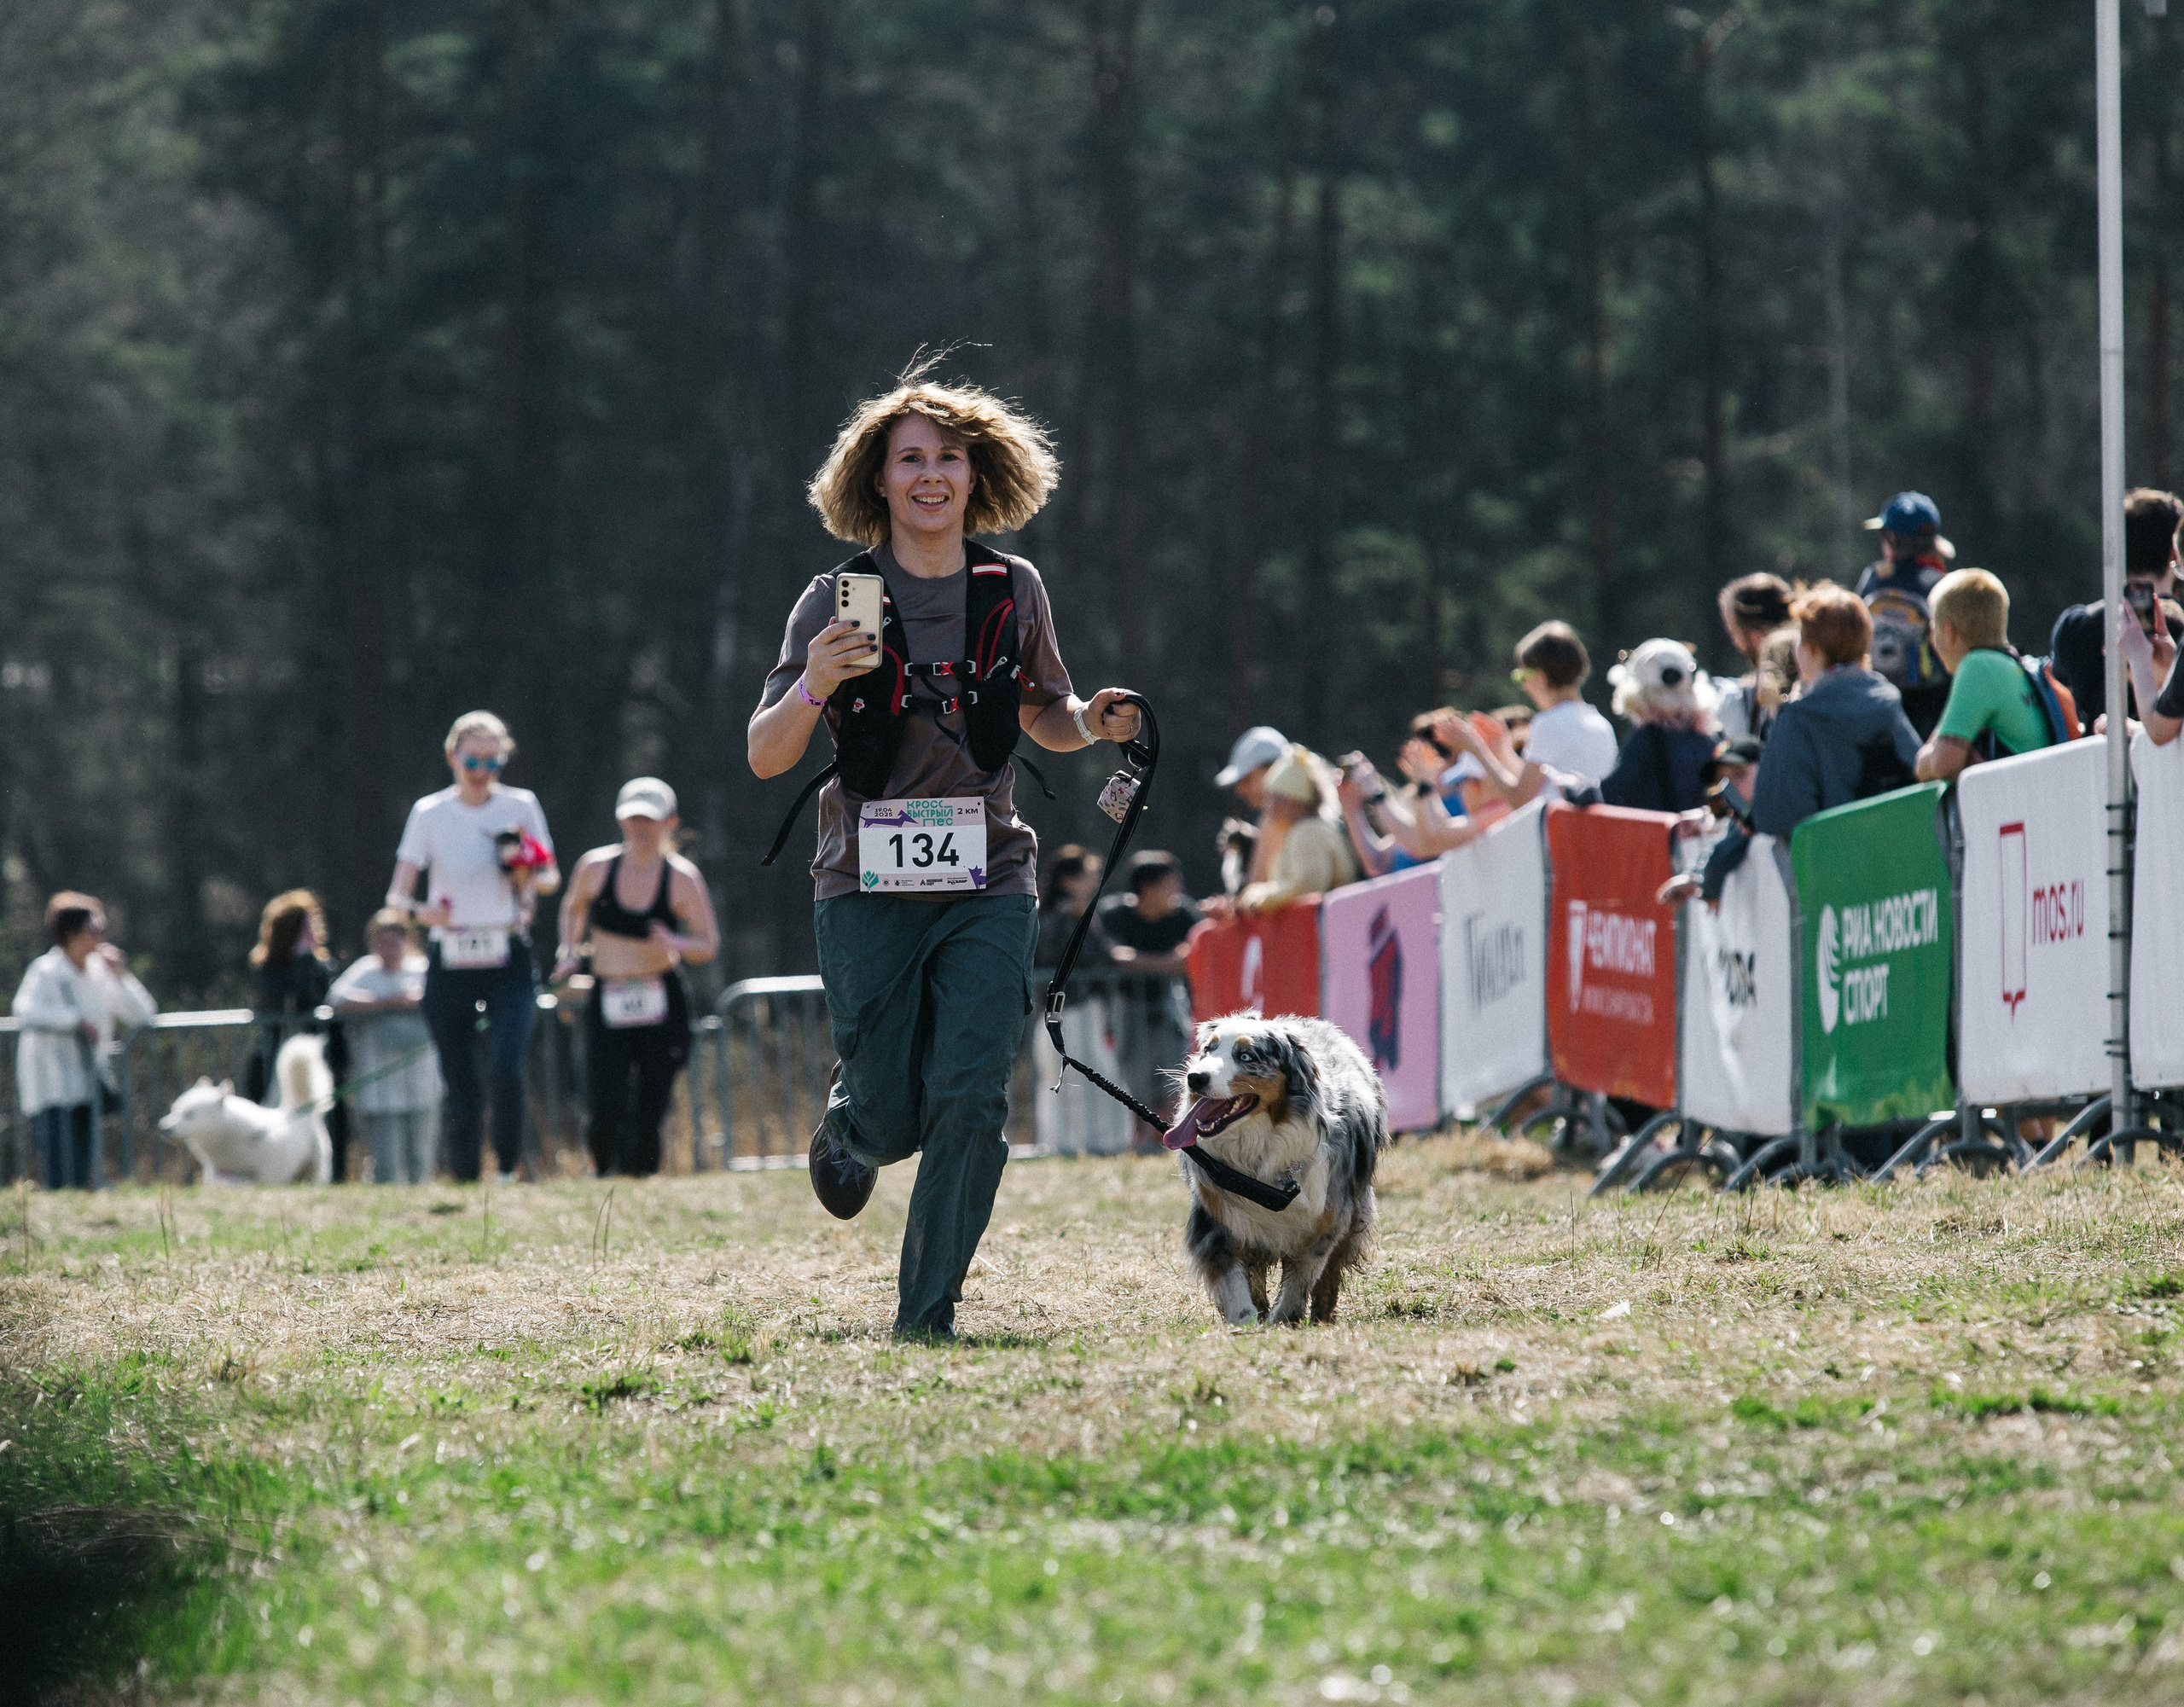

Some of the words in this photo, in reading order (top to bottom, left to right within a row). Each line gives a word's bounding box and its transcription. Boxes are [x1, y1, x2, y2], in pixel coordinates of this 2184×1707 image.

[889, 833, 960, 868] 134
[1842, 903, 1872, 959] РИА
[1875, 887, 1938, 955] НОВОСТИ
[2032, 878, 2084, 945] mos.ru
[1843, 964, 1889, 1025] СПОРТ
